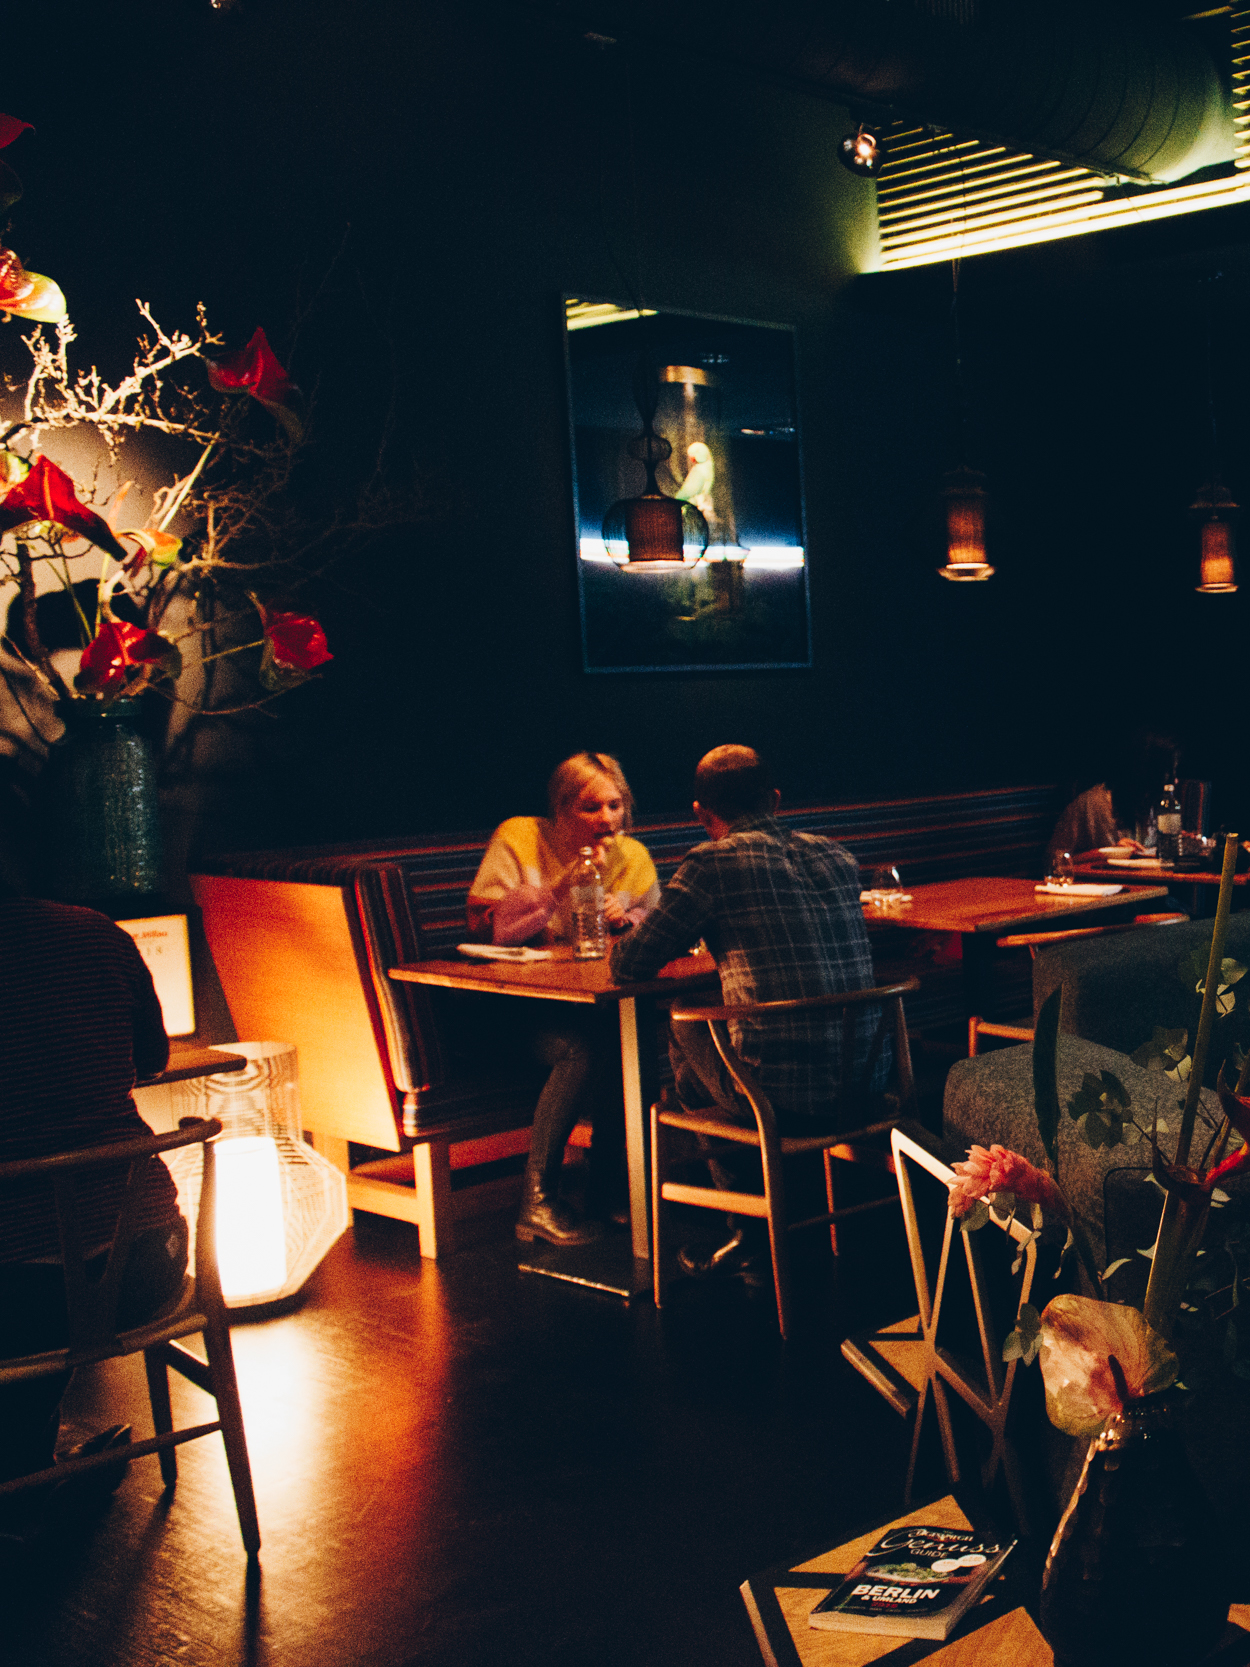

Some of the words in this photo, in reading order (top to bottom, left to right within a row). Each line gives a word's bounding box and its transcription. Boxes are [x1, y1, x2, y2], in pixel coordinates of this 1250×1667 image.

[866, 1529, 1000, 1556] Genuss
[911, 1549, 948, 1558] GUIDE
[852, 1584, 941, 1600] BERLIN
[872, 1596, 918, 1604] UMLAND
